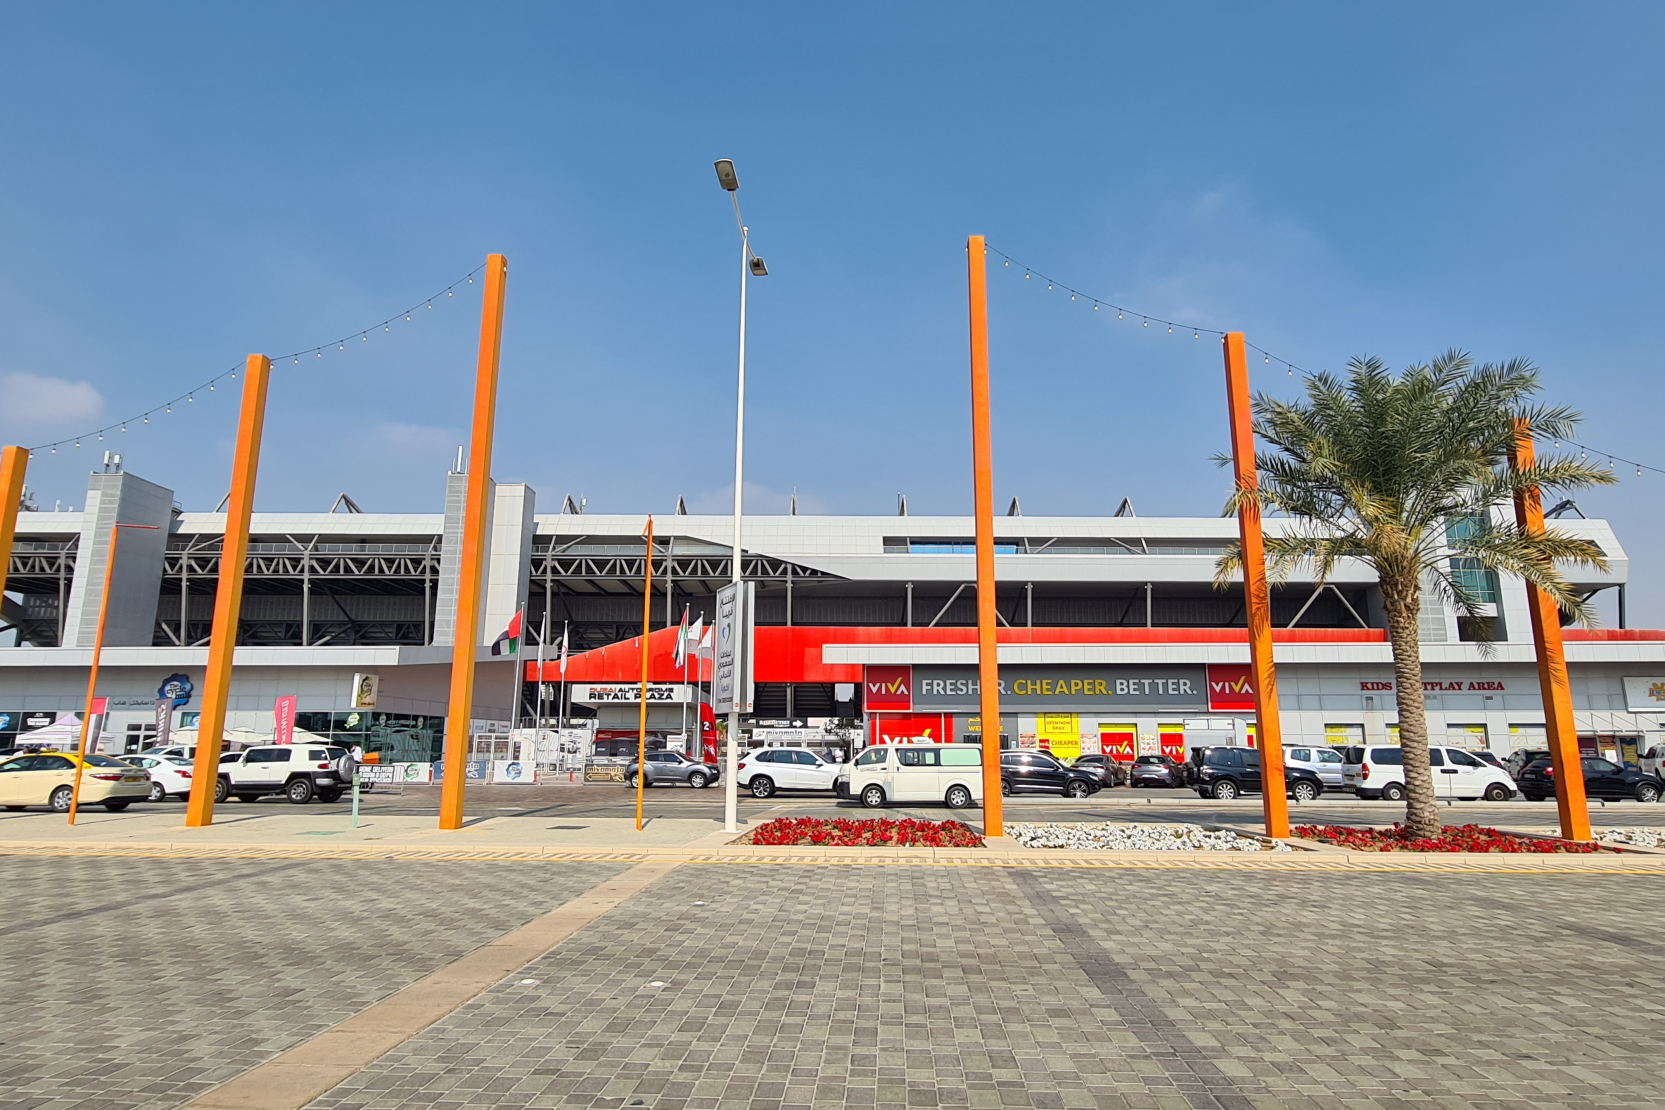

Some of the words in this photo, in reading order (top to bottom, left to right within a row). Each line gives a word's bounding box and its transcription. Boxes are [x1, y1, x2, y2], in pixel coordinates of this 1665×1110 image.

[868, 677, 908, 694] VIVA
[922, 680, 1011, 695] FRESHR.
[1013, 679, 1112, 695] CHEAPER.
[1115, 679, 1197, 695] BETTER.
[1211, 676, 1253, 694] VIVA
[1360, 682, 1393, 691] KIDS
[1467, 682, 1505, 691] AREA
[1103, 741, 1133, 754] VIVA
[1163, 746, 1184, 754] VIV
